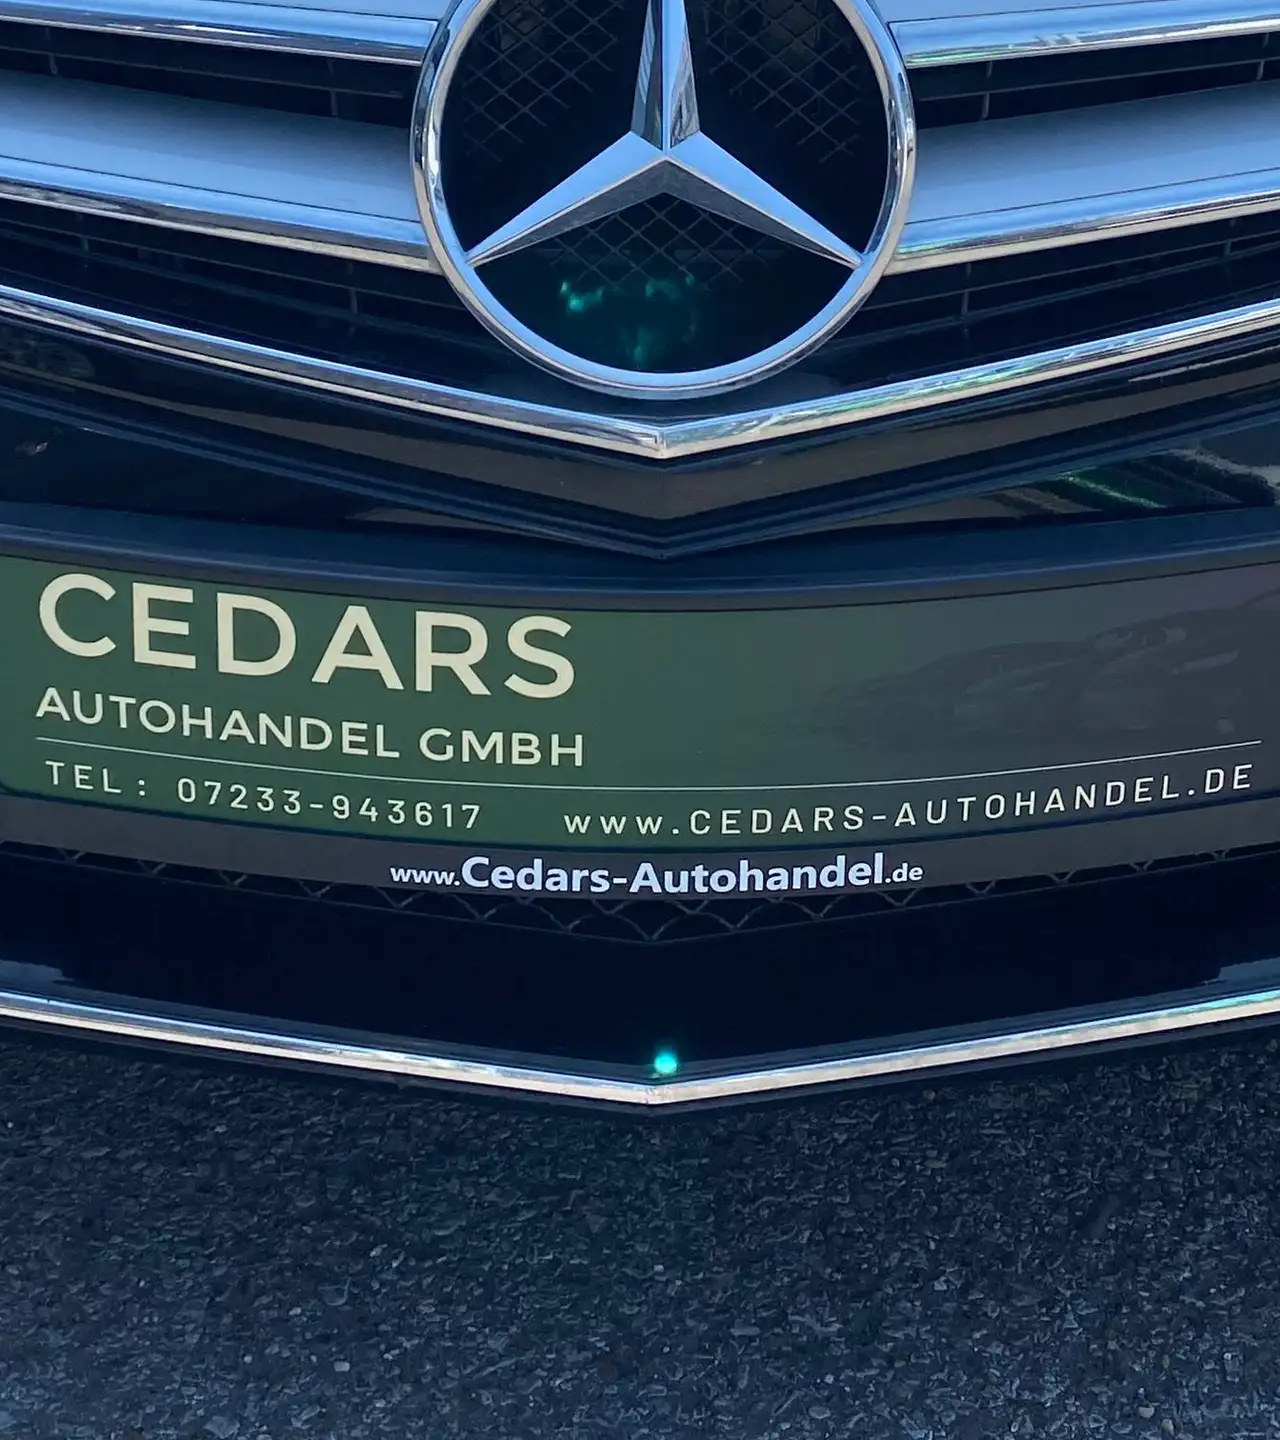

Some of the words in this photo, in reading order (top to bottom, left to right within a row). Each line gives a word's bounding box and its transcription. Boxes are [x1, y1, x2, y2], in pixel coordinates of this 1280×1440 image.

[38, 572, 576, 699] CEDARS
[35, 686, 400, 758] AUTOHANDEL
[419, 728, 584, 767] GMBH
[45, 760, 147, 797] TEL:
[176, 777, 481, 830] 07233-943617
[389, 851, 925, 894] www.Cedars-Autohandel.de
